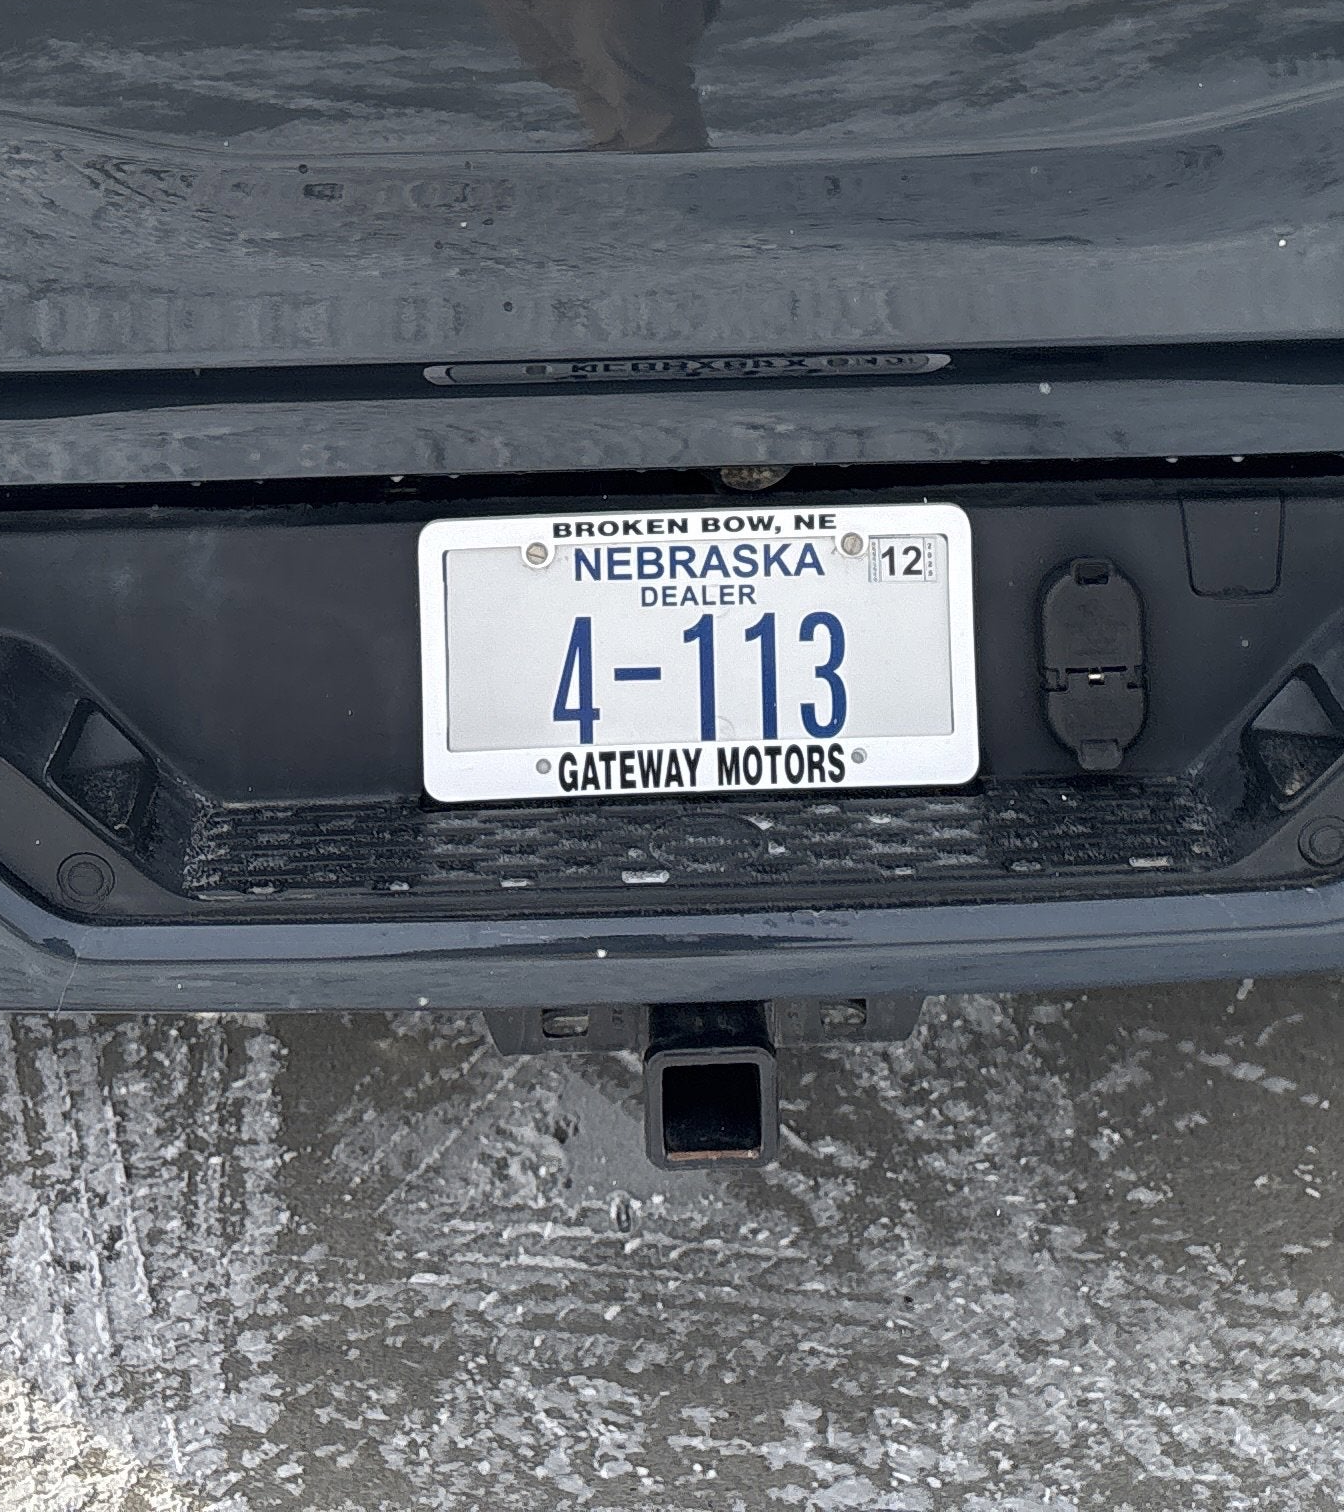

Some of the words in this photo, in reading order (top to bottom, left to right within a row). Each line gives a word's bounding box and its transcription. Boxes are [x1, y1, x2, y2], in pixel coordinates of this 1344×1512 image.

[553, 518, 688, 538] BROKEN
[701, 515, 782, 535] BOW,
[793, 514, 836, 530] NE
[574, 543, 825, 582] NEBRASKA
[881, 545, 923, 577] 12
[640, 585, 757, 607] DEALER
[552, 612, 848, 745] 4-113
[557, 748, 703, 793] GATEWAY
[717, 744, 847, 784] MOTORS
